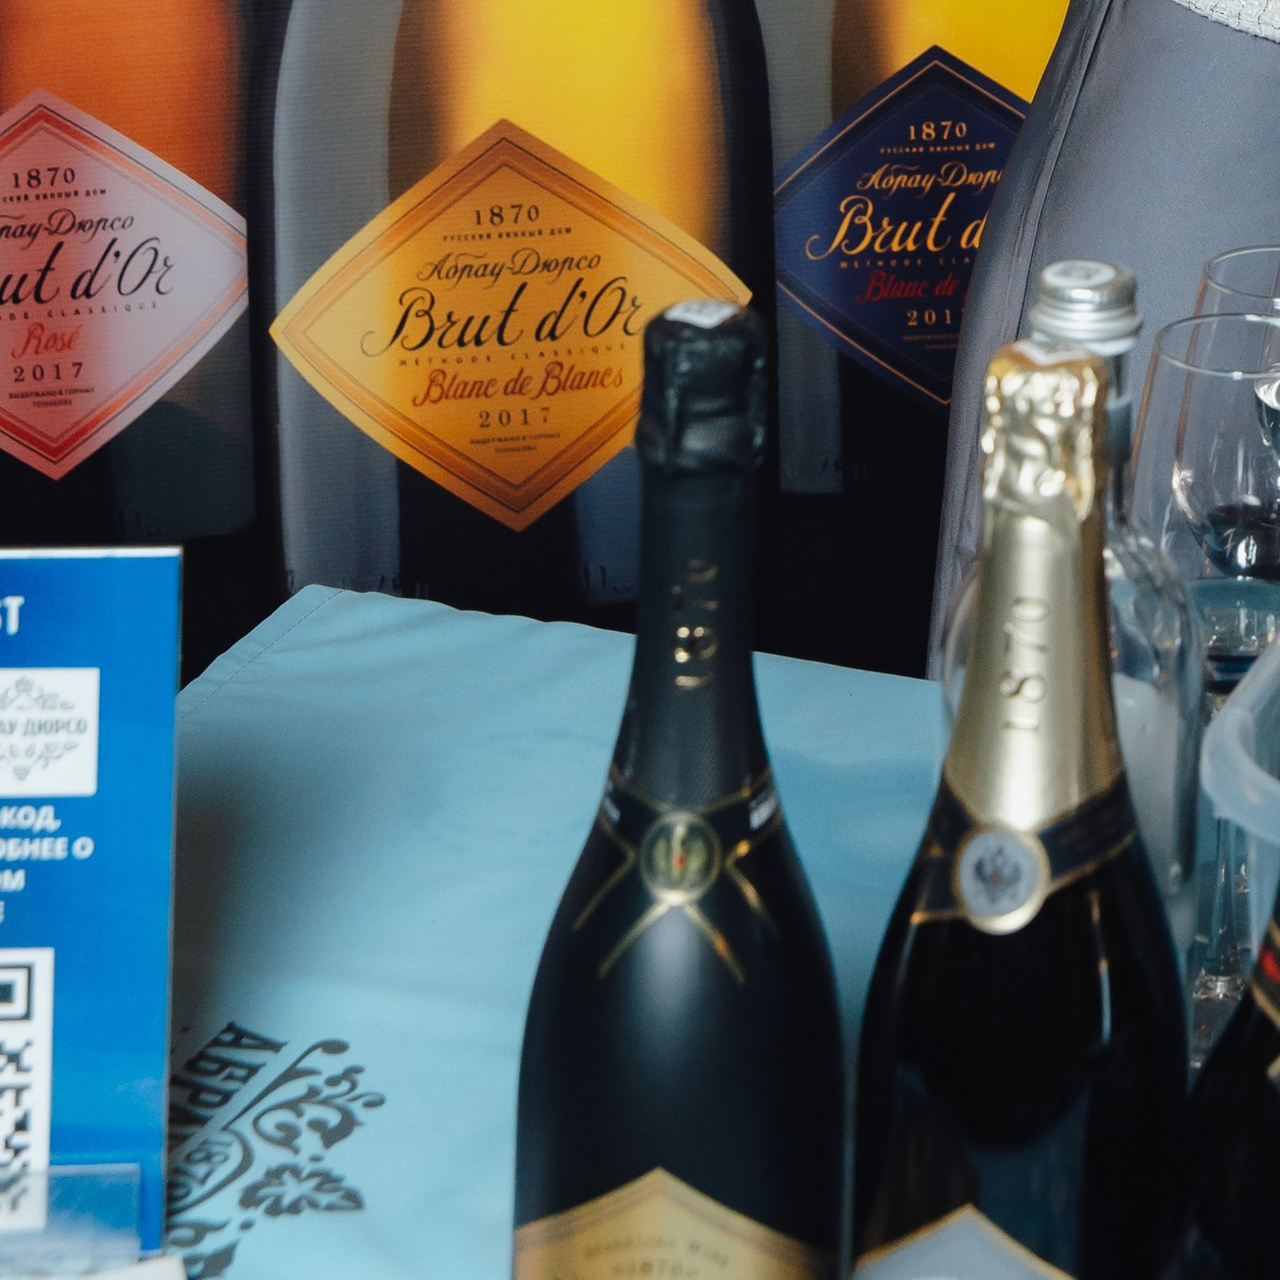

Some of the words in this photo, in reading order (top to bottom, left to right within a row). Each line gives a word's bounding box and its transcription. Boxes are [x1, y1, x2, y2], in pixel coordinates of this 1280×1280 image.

[908, 121, 968, 141] 1870
[12, 167, 76, 189] 1870
[475, 204, 540, 227] 1870
[806, 192, 956, 262] Brut
[70, 236, 175, 302] d'Or
[416, 247, 601, 291] Абрау-Дюрсо
[360, 281, 529, 357] Brut
[535, 276, 646, 343] d'Or
[907, 308, 964, 328] 201
[11, 321, 80, 358] Rosé
[13, 361, 84, 383] 2017
[412, 368, 499, 408] Blanc
[502, 366, 534, 397] de
[530, 360, 624, 401] Blancs
[479, 406, 550, 429] 2017
[1000, 596, 1050, 731] 1870
